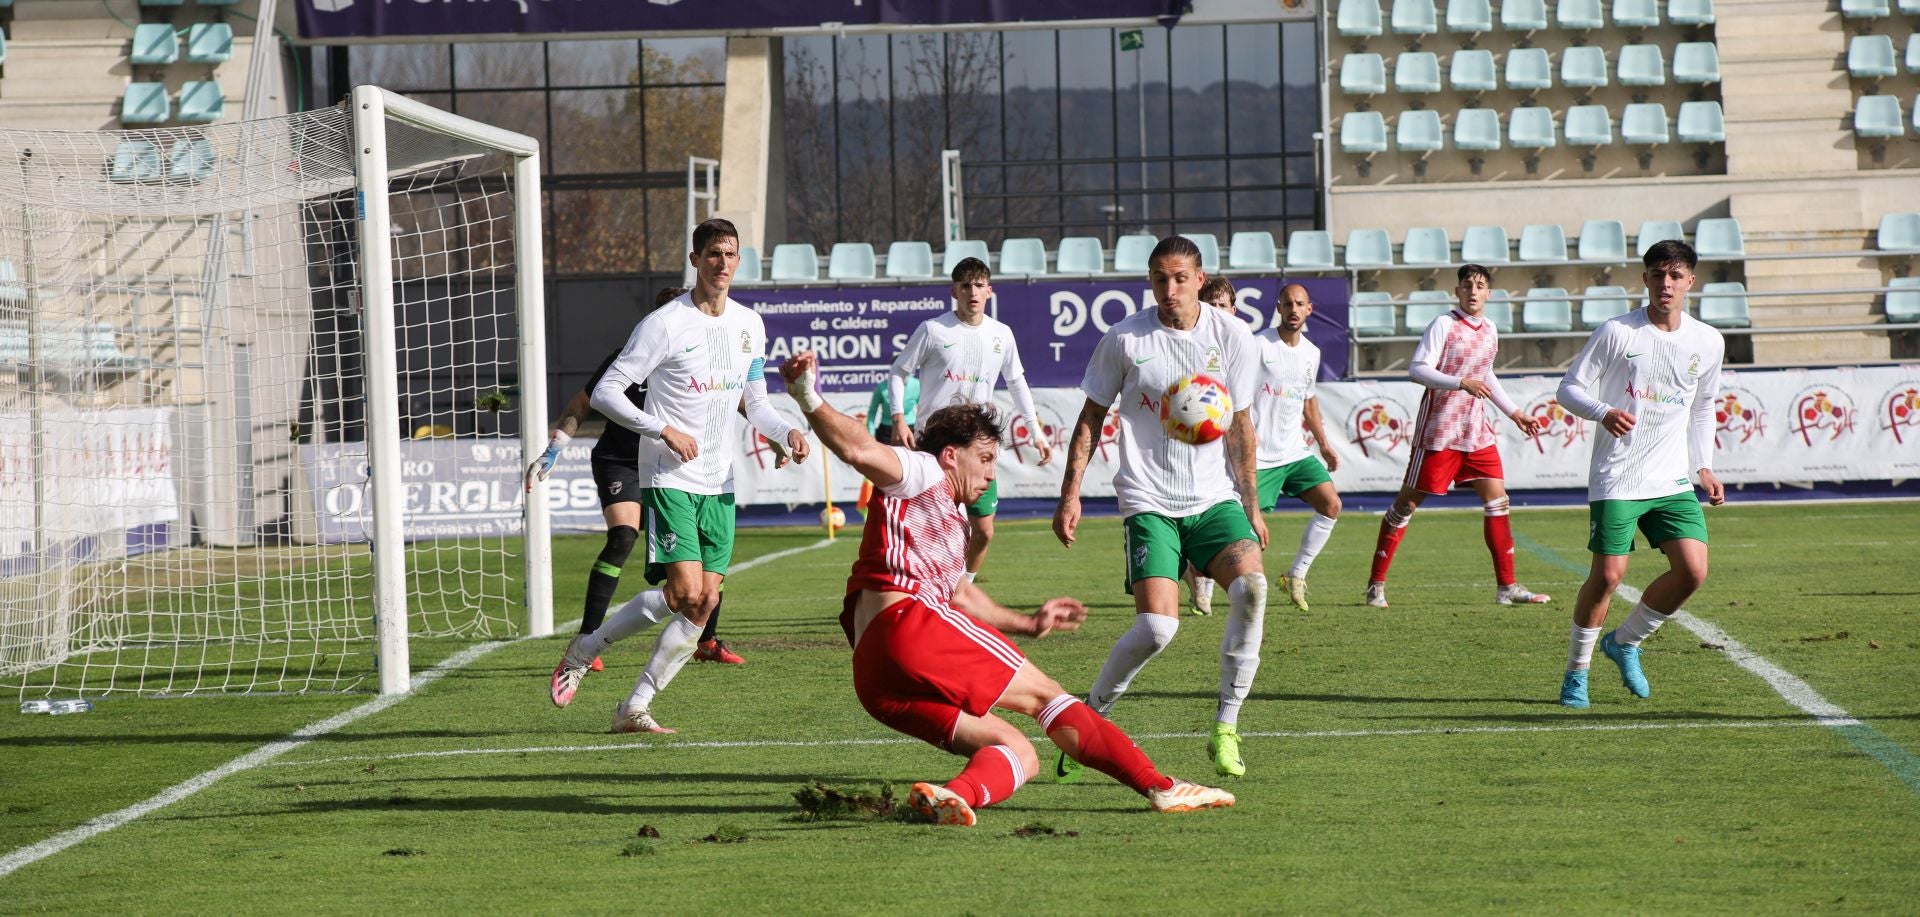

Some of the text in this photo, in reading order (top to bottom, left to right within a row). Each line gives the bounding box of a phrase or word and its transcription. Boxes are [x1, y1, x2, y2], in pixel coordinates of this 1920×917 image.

[753, 297, 945, 315] Mantenimiento y Reparación
[810, 316, 889, 330] de Calderas
[765, 334, 881, 361] ARRION
[1624, 380, 1686, 406] Andalucía
